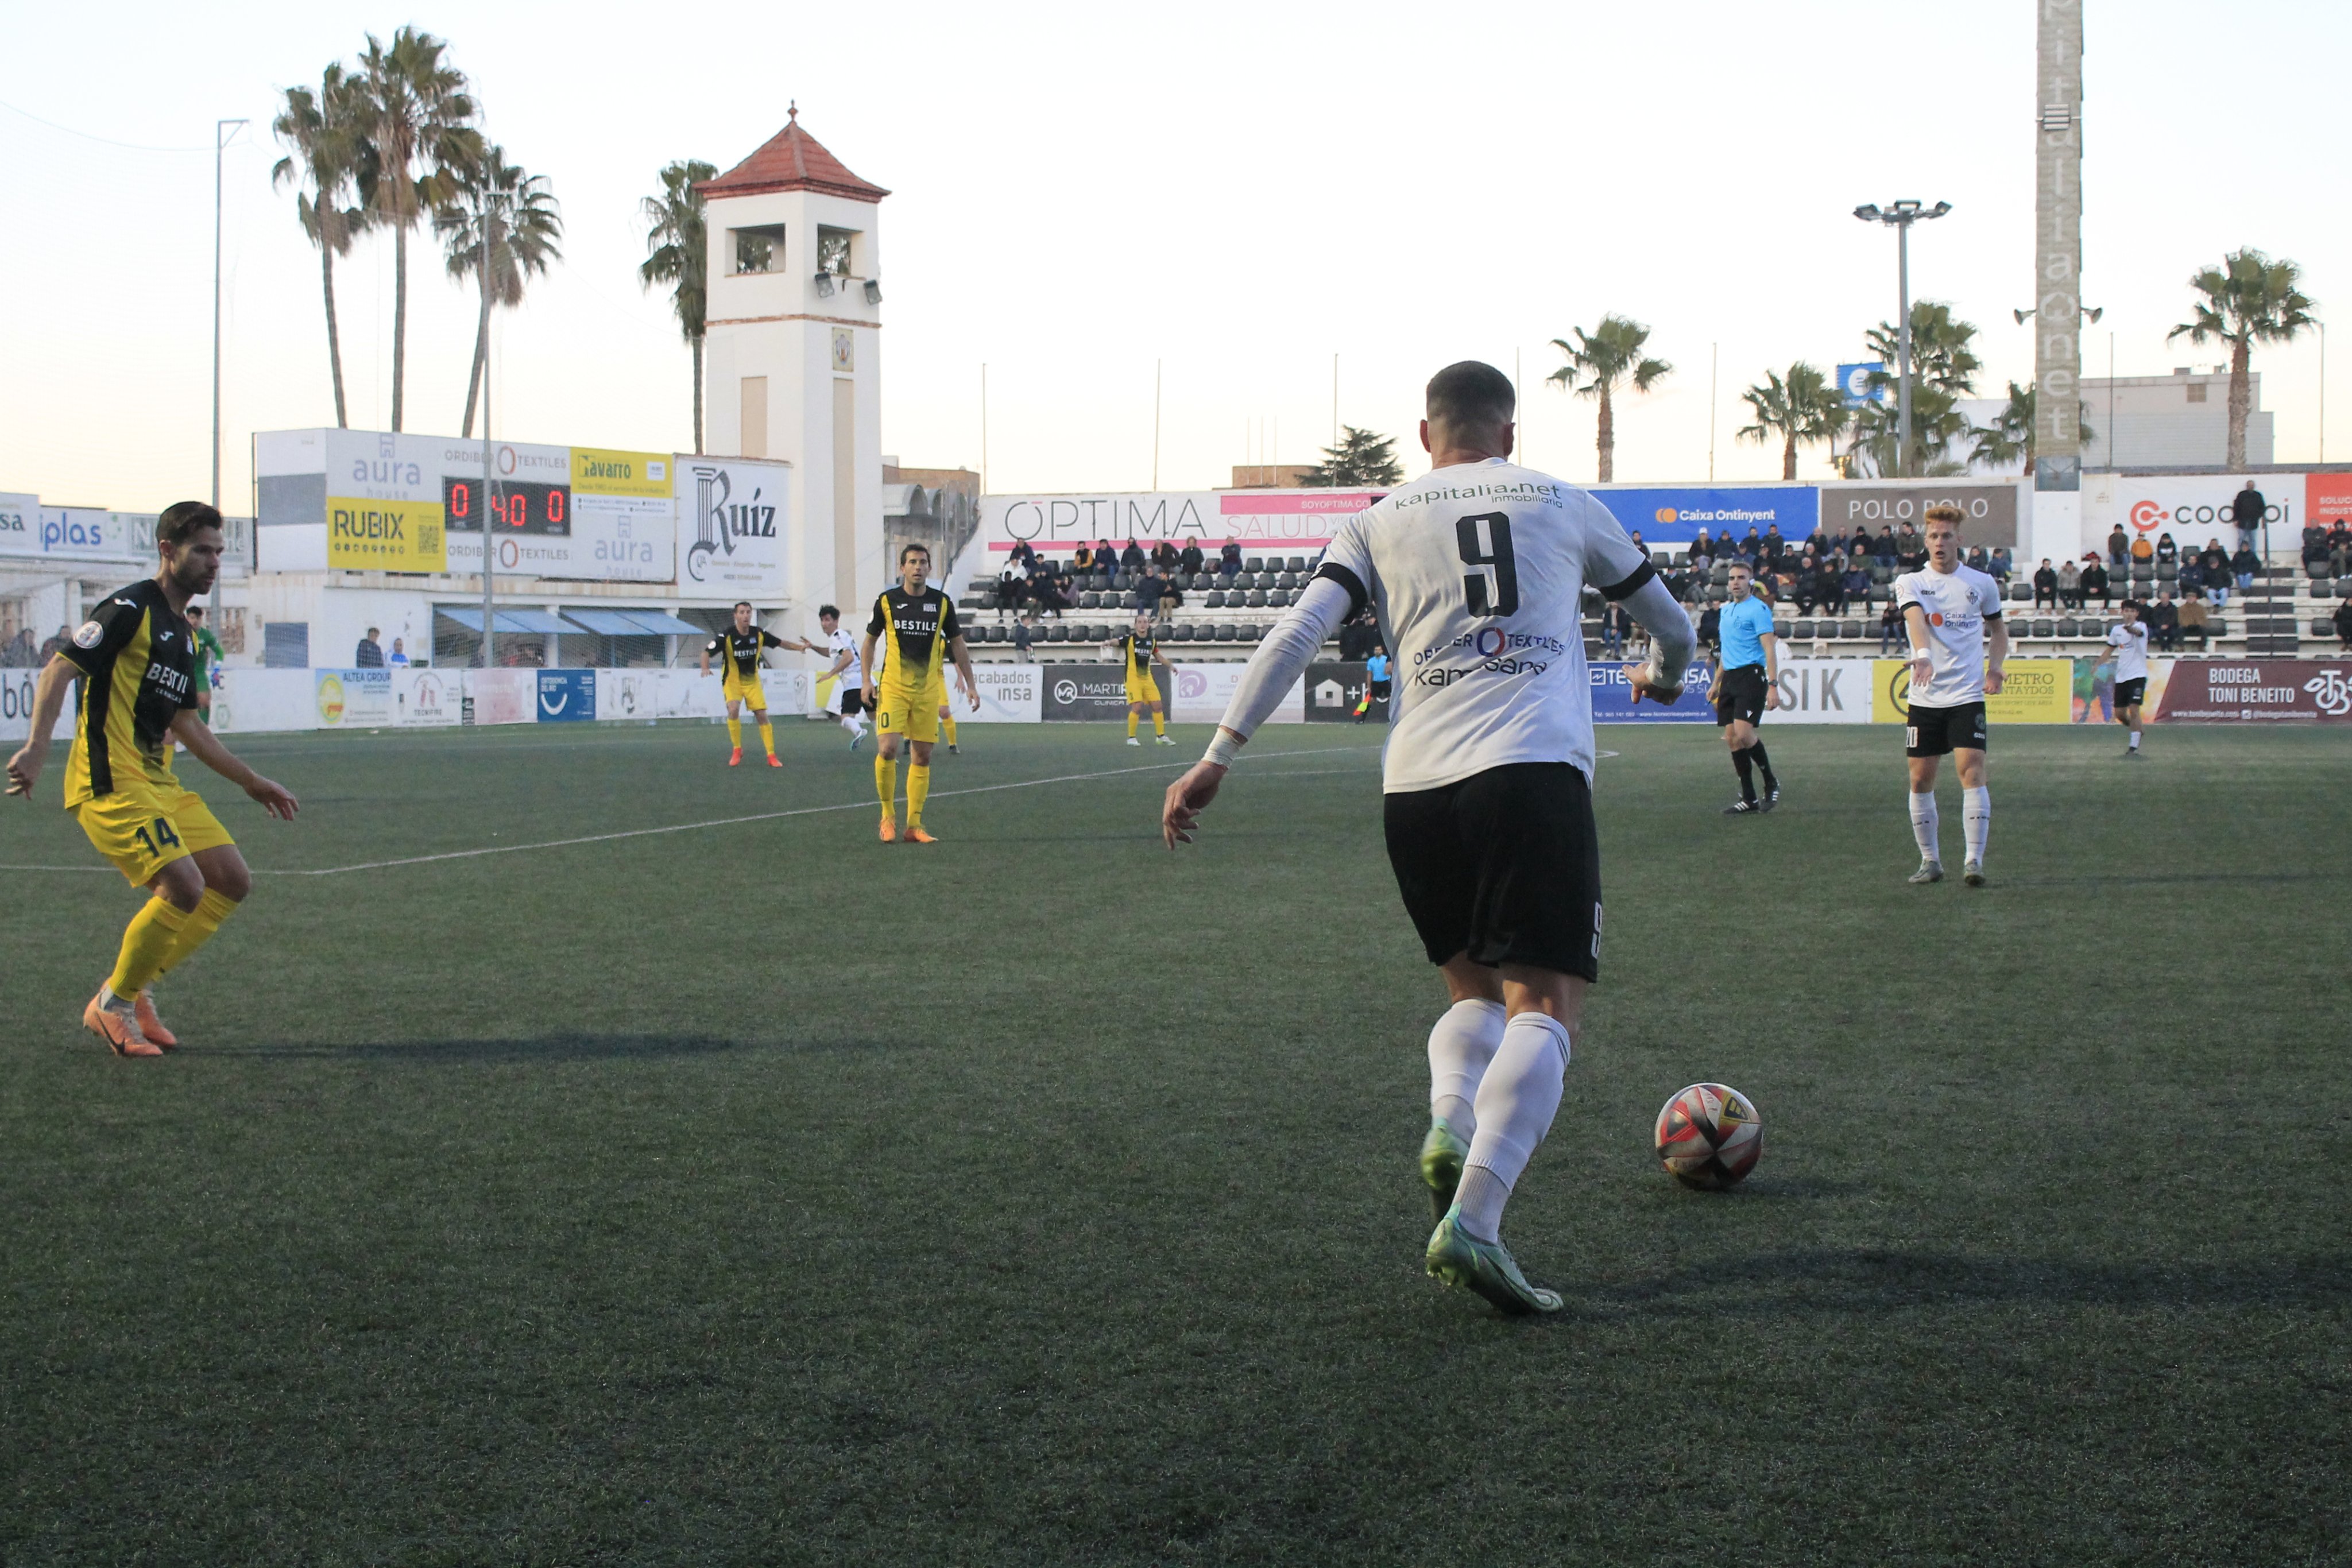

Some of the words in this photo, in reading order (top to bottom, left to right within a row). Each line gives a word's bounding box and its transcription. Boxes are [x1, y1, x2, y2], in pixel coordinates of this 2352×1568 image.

[353, 459, 421, 485] aura
[518, 455, 567, 469] TEXTILES
[452, 484, 469, 517] 0
[492, 494, 527, 526] 40
[548, 490, 564, 522] 0
[1301, 501, 1371, 509] SOYOPTIMA.CO
[1849, 500, 1913, 520] POLO
[334, 510, 404, 540] RUBIX
[1005, 499, 1207, 540] OPTIMA
[1680, 509, 1714, 521] Caixa
[1715, 509, 1775, 524] Ontinyent
[39, 513, 102, 552] iplas
[1228, 516, 1327, 539] SALUD
[448, 545, 497, 558] ORDIBR
[520, 548, 568, 560] TEXTILES
[595, 539, 653, 563] aura
[1456, 511, 1519, 618] 9
[894, 620, 937, 631] BESTILE
[2208, 668, 2261, 683] BODEGA
[998, 688, 1031, 702] insa
[2208, 688, 2238, 703] TONI
[2241, 688, 2295, 703] BENEITO
[135, 816, 180, 858] 14
